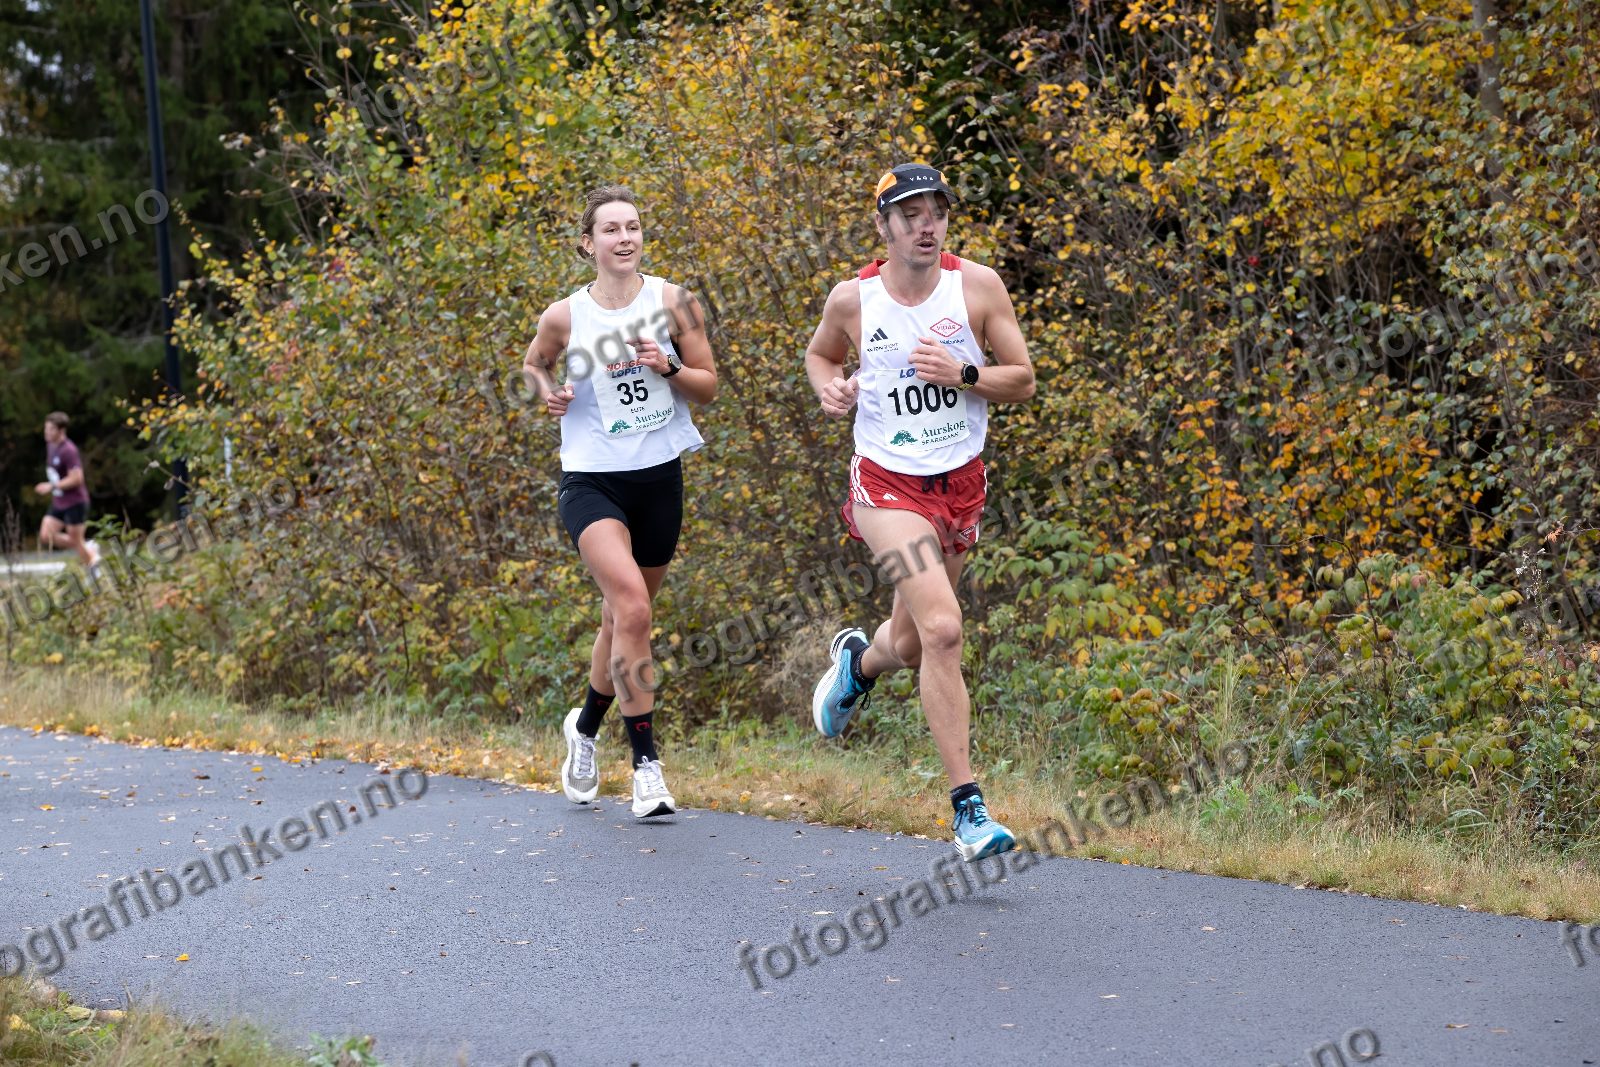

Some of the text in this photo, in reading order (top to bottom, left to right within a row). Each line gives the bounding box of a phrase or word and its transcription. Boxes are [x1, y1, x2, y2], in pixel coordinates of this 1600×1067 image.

[616, 378, 649, 406] 35
[887, 382, 958, 417] 1006
[634, 407, 673, 425] Aurskog
[920, 420, 966, 439] Aurskog
